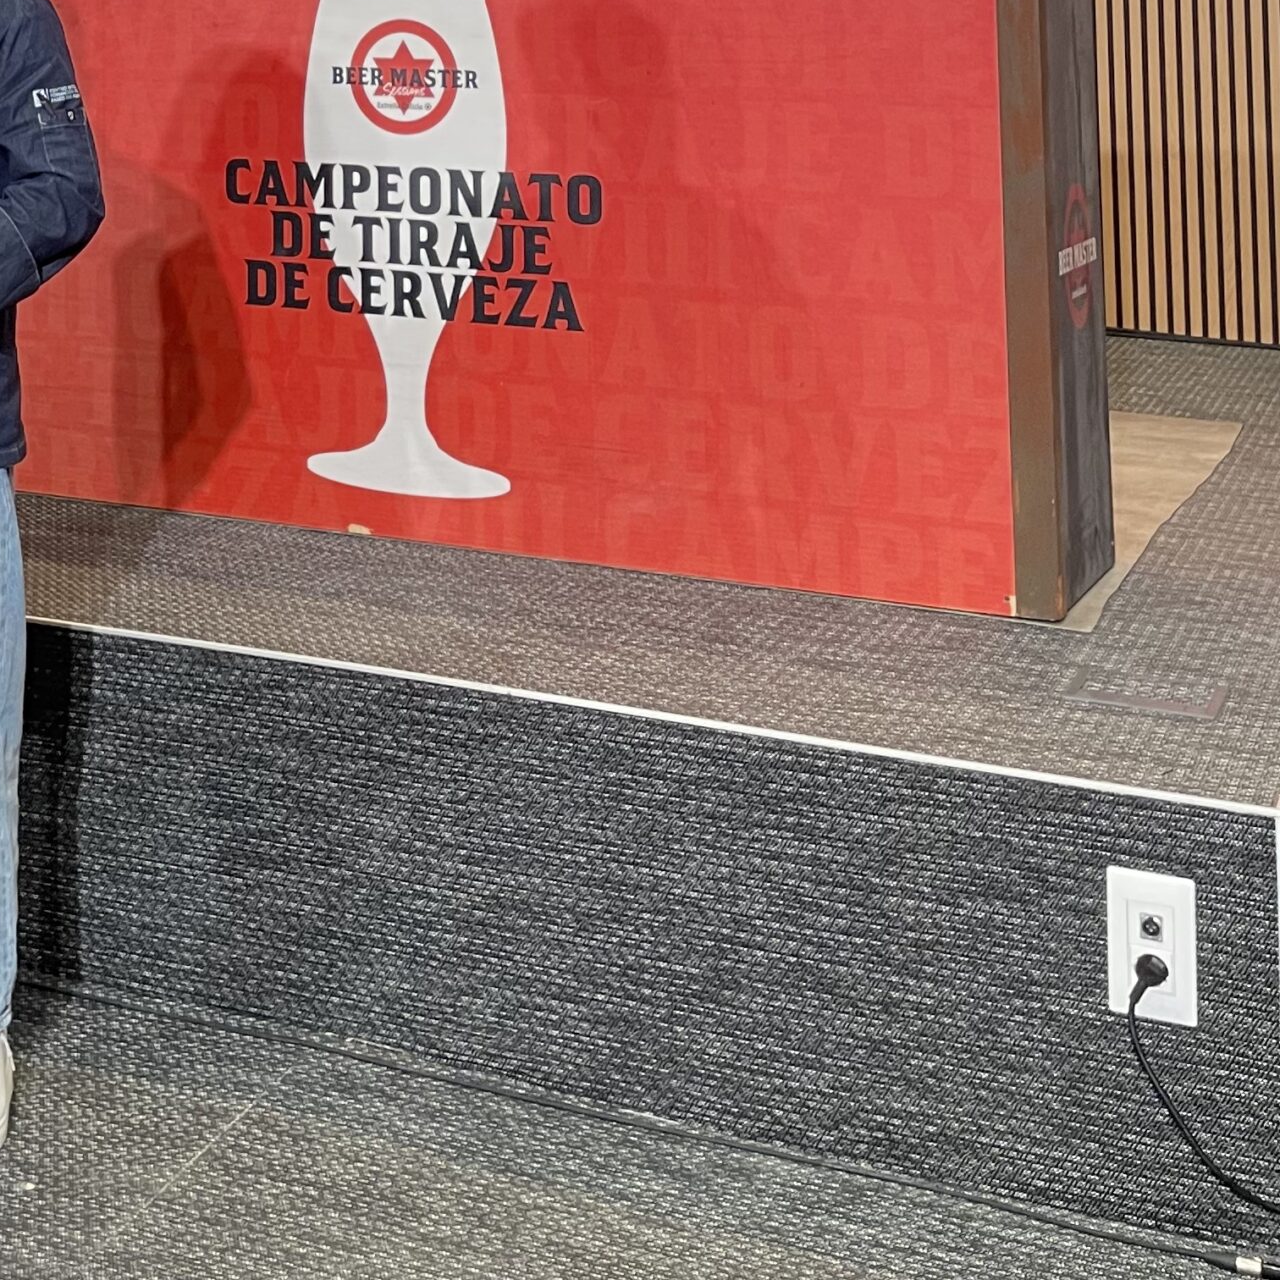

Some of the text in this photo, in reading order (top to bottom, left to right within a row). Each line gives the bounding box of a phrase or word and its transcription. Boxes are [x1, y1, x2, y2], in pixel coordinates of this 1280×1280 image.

[331, 66, 479, 89] BEER MASTER
[225, 158, 603, 226] CAMPEONATO
[270, 210, 553, 276] DE TIRAJE
[245, 258, 585, 333] DE CERVEZA
